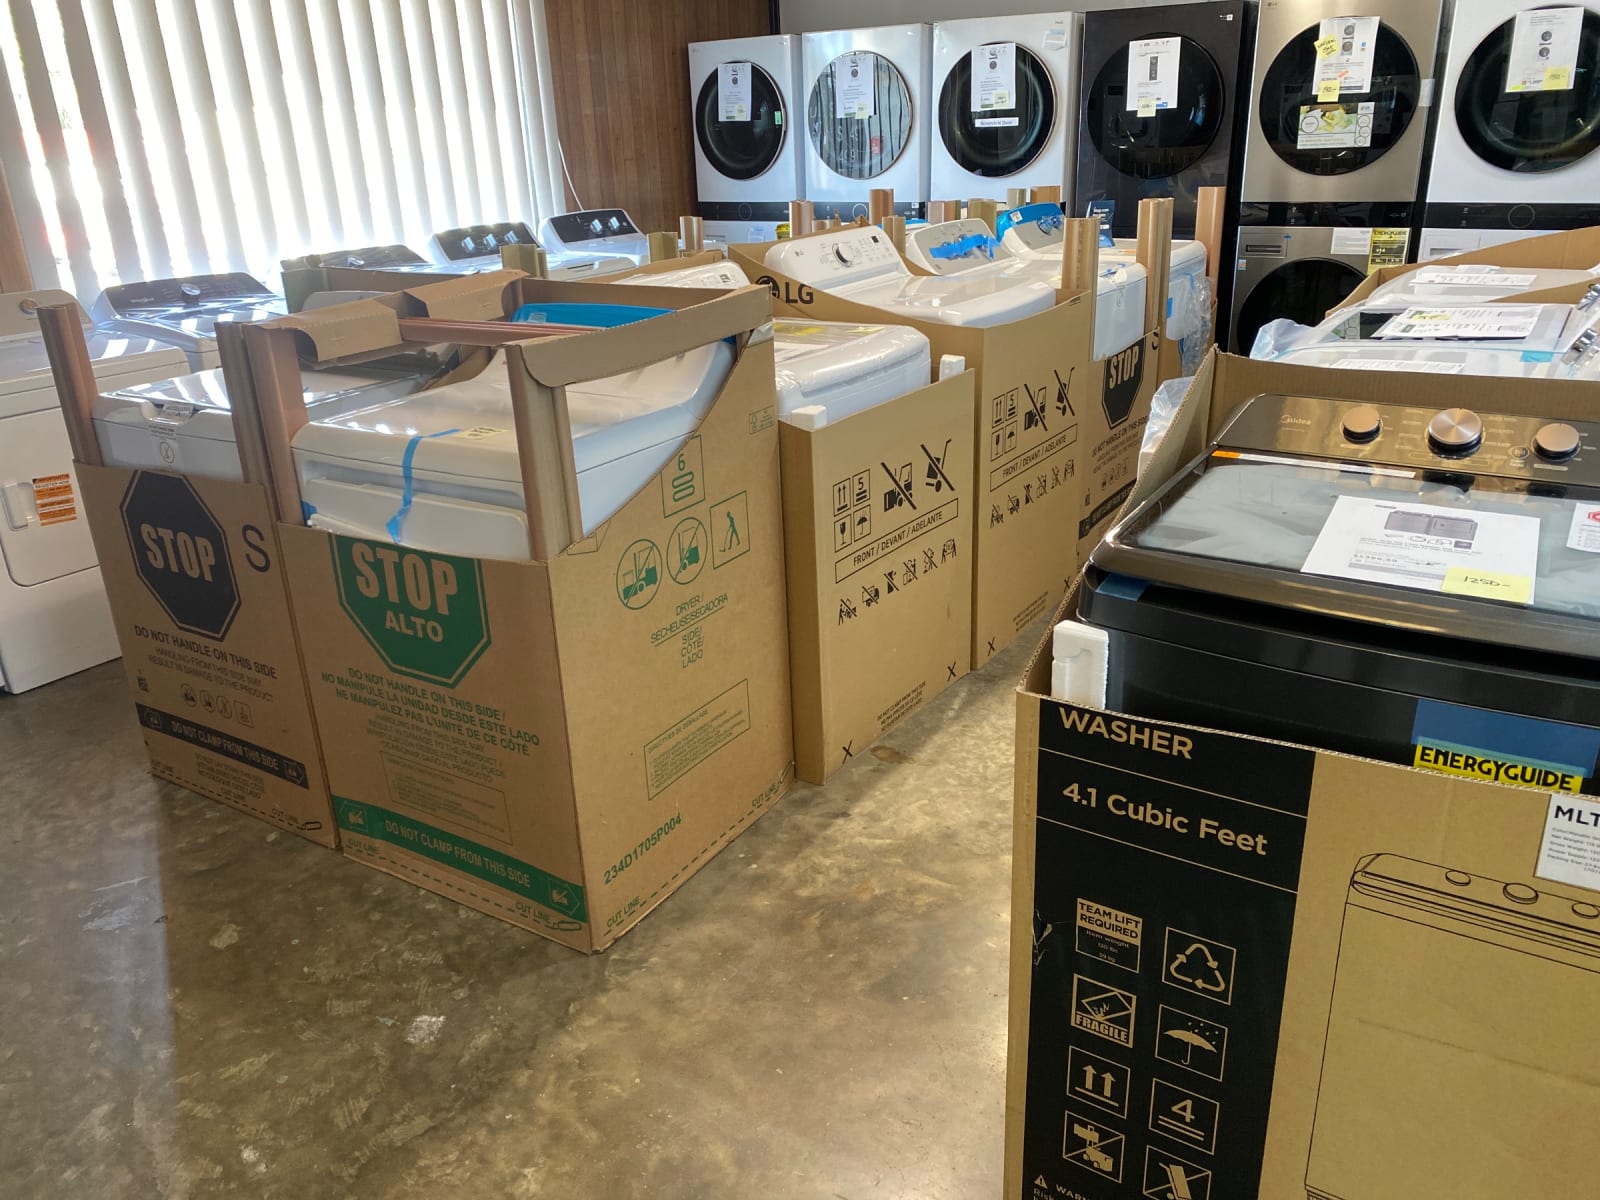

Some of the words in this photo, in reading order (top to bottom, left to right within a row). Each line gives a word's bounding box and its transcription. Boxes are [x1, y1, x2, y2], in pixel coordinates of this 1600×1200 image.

[785, 281, 814, 304] LG
[1109, 345, 1140, 389] STOP
[1280, 413, 1312, 425] Midea
[677, 453, 686, 471] 6
[1002, 464, 1018, 478] FRONT
[1023, 452, 1041, 469] DEVANT
[1045, 435, 1067, 455] ADELANTE
[858, 477, 864, 490] 5
[140, 523, 216, 582] STOP
[242, 524, 270, 573] S
[854, 545, 875, 567] FRONT
[881, 530, 906, 551] DEVANT
[911, 511, 943, 533] ADELANTE
[352, 542, 458, 616] STOP
[385, 611, 444, 643] ALTO
[134, 625, 149, 639] DO
[151, 629, 170, 645] NOT
[171, 635, 212, 657] HANDLE
[213, 647, 228, 662] ON
[230, 653, 252, 671] THIS
[253, 661, 278, 679] SIDE
[682, 649, 704, 669] LADO
[321, 671, 335, 684] NO
[337, 675, 385, 699] MANIPULE
[386, 691, 402, 705] LA
[402, 695, 440, 716] UNIDAD
[441, 706, 477, 727] DESDE
[479, 717, 508, 735] ESTE
[509, 725, 540, 746] LADO
[348, 667, 363, 681] DO
[365, 670, 385, 687] NOT
[388, 679, 428, 699] HANDLE
[430, 691, 446, 705] ON
[448, 696, 473, 713] THIS
[475, 703, 500, 720] SIDE
[335, 688, 349, 700] NE
[350, 692, 403, 717] MANIPULEZ
[405, 710, 425, 725] PAS
[466, 728, 480, 740] DE
[483, 733, 498, 747] CE
[1058, 706, 1194, 760] WASHER
[171, 720, 182, 733] DO
[182, 724, 197, 740] NOT
[198, 728, 223, 748] CLAMP
[222, 738, 243, 756] FROM
[243, 746, 261, 764] THIS
[262, 753, 279, 771] SIDE
[1419, 746, 1574, 791] ENERGYGUIDE
[1062, 783, 1097, 808] 4.1
[1107, 794, 1190, 834] Cubic
[1199, 817, 1268, 856] Feet
[385, 819, 400, 834] DO
[400, 824, 420, 842] NOT
[421, 832, 453, 855] CLAMP
[454, 846, 482, 867] FROM
[482, 857, 506, 878] THIS
[507, 866, 531, 889] SIDE
[603, 812, 682, 885] 234D1705P004
[515, 901, 531, 914] CUT
[606, 909, 623, 928] CUT
[622, 895, 641, 917] LINE
[1079, 901, 1112, 922] TEAM
[1115, 911, 1141, 930] LIFT
[1080, 913, 1138, 940] REQUIRED
[1086, 929, 1103, 940] Item
[1104, 935, 1131, 949] weight
[1075, 1013, 1129, 1044] FRAGILE
[1171, 1099, 1195, 1123] 4
